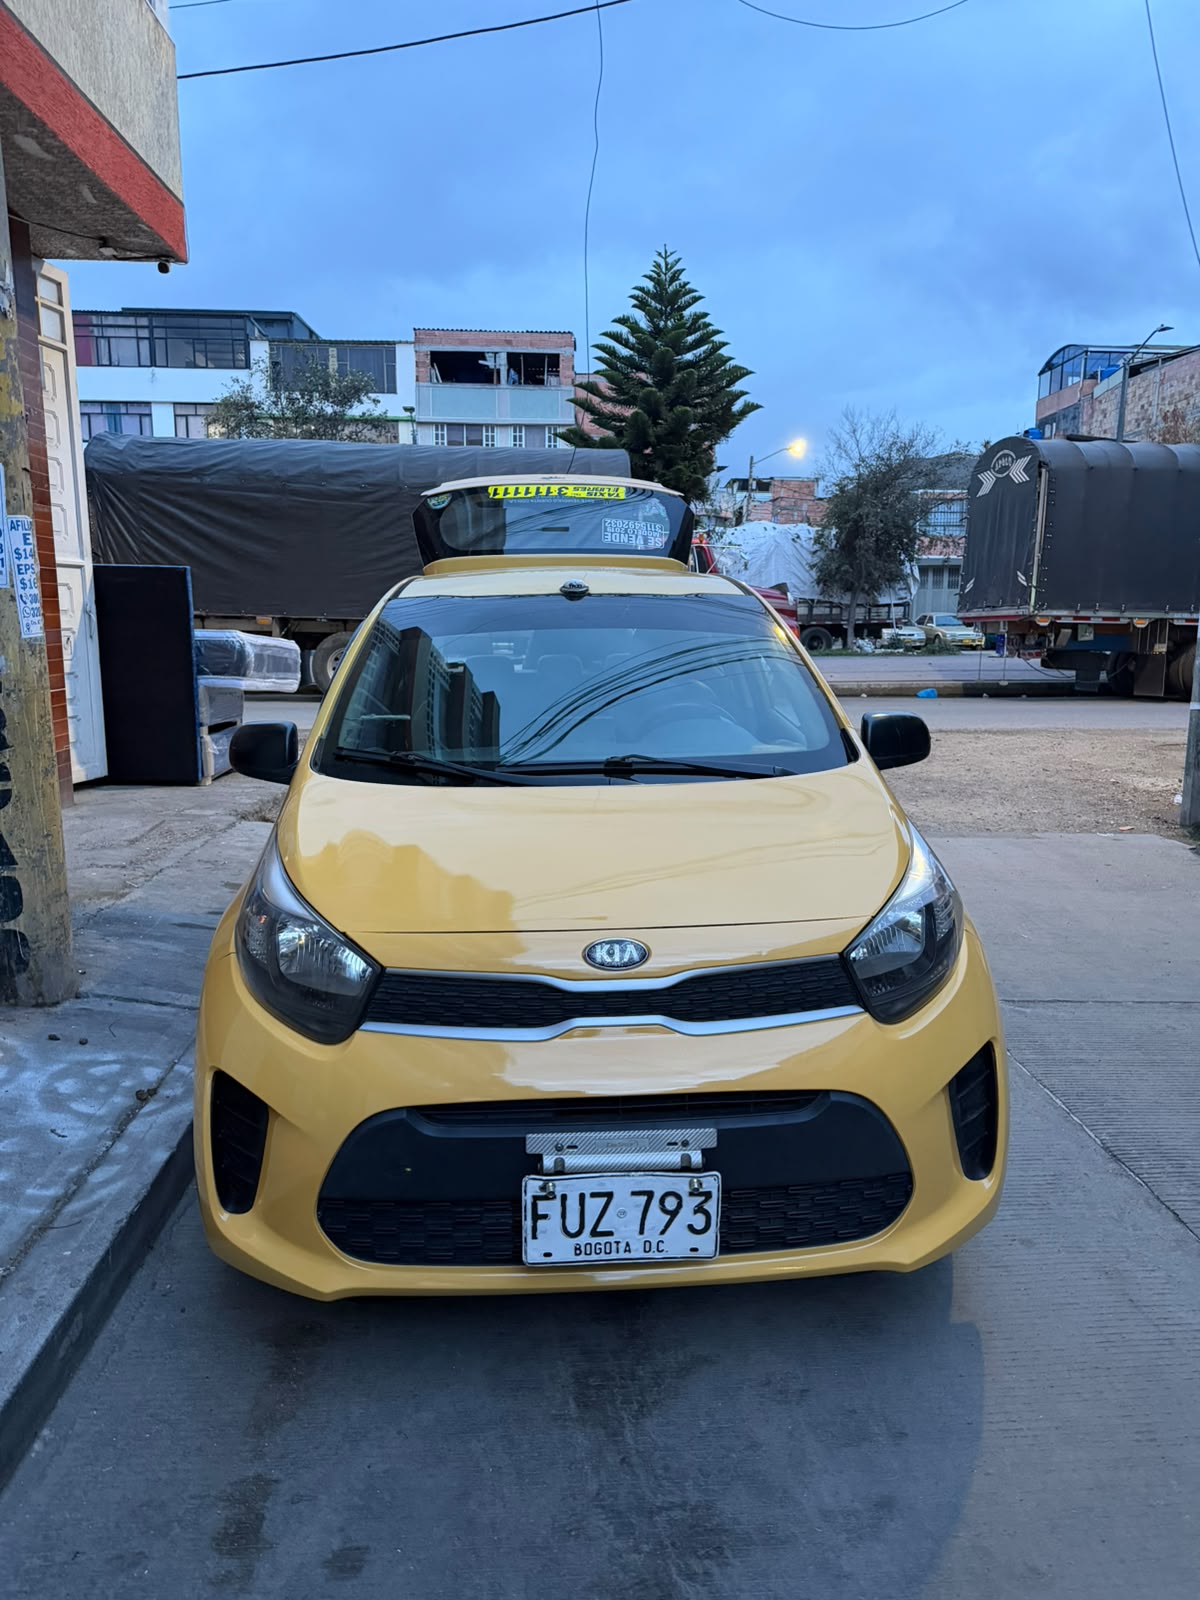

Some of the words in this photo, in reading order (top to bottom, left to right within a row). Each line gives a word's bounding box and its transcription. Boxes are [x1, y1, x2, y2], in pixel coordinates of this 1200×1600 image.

[604, 532, 644, 545] VENDE
[648, 536, 662, 547] SE
[595, 943, 640, 962] KIA
[531, 1191, 615, 1240] FUZ
[630, 1190, 713, 1235] 793
[574, 1240, 631, 1256] BOGOTA
[643, 1240, 668, 1253] D.C.
